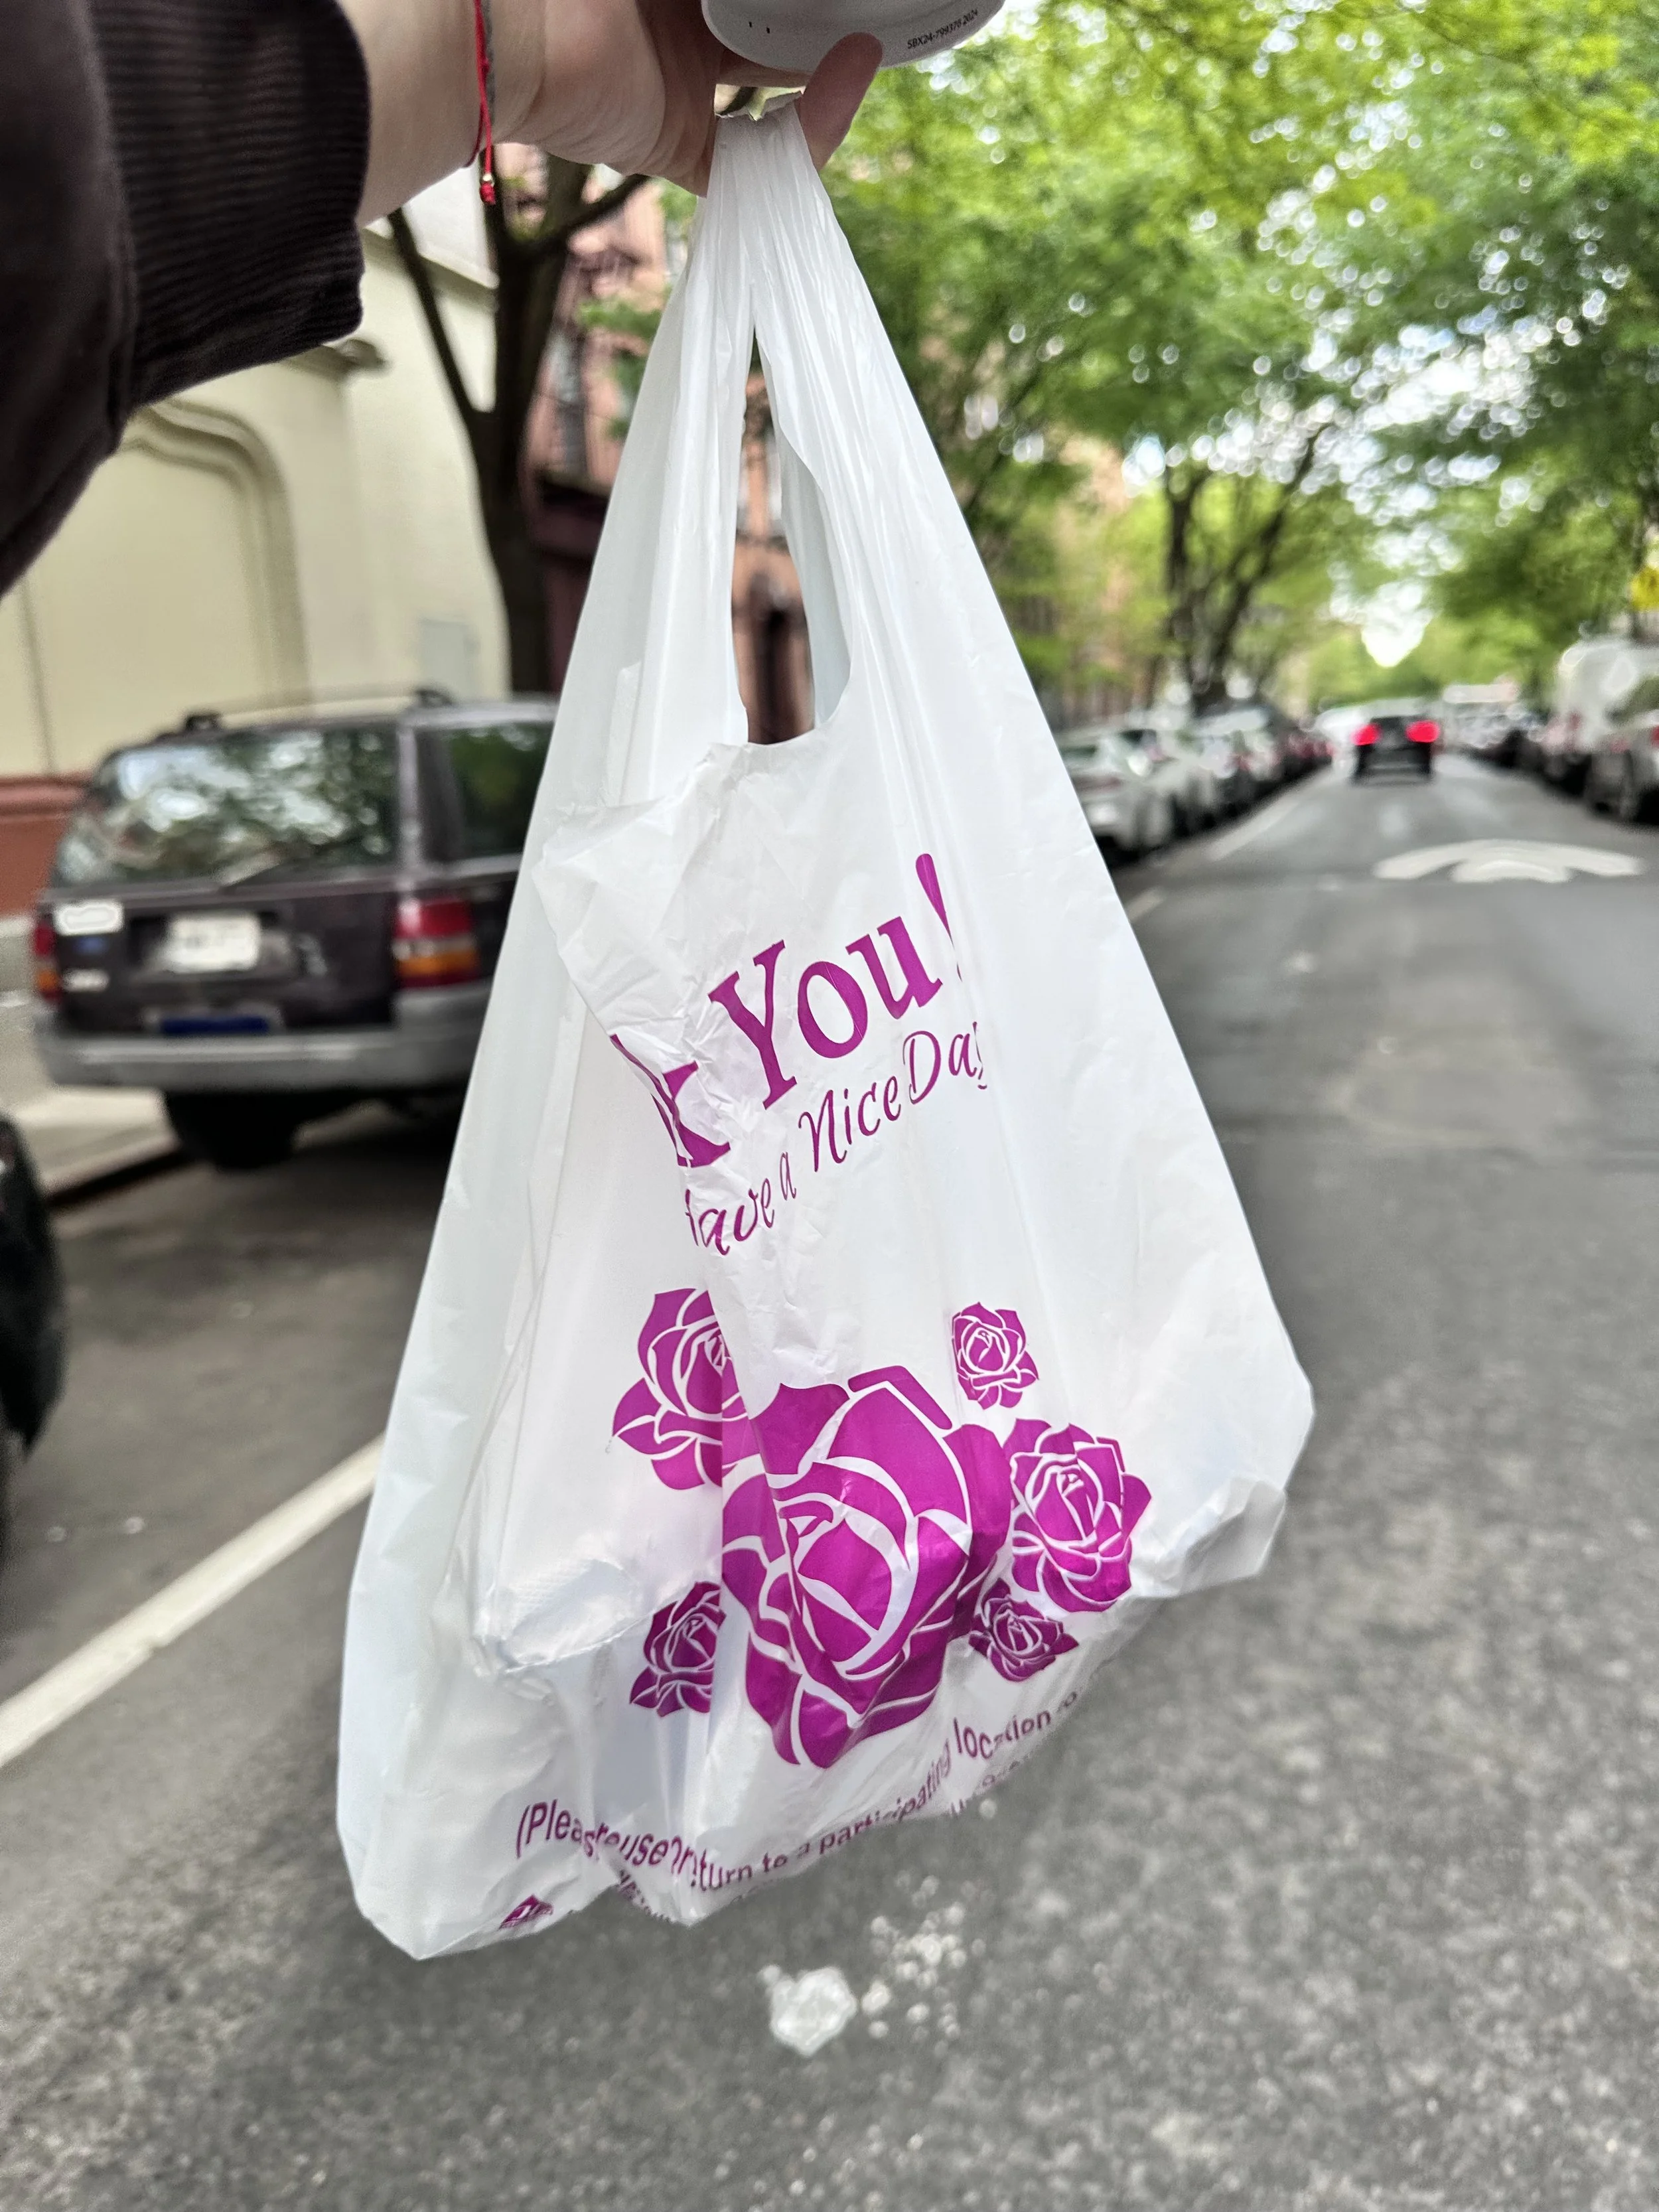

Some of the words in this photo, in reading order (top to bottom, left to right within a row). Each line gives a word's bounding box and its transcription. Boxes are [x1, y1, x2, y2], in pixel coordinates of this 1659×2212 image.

[707, 853, 963, 1110] You!
[684, 1177, 775, 1256] ave
[779, 1151, 797, 1201] a
[798, 1075, 901, 1173] Nice
[902, 1021, 988, 1106] Da
[762, 1852, 788, 1873] to
